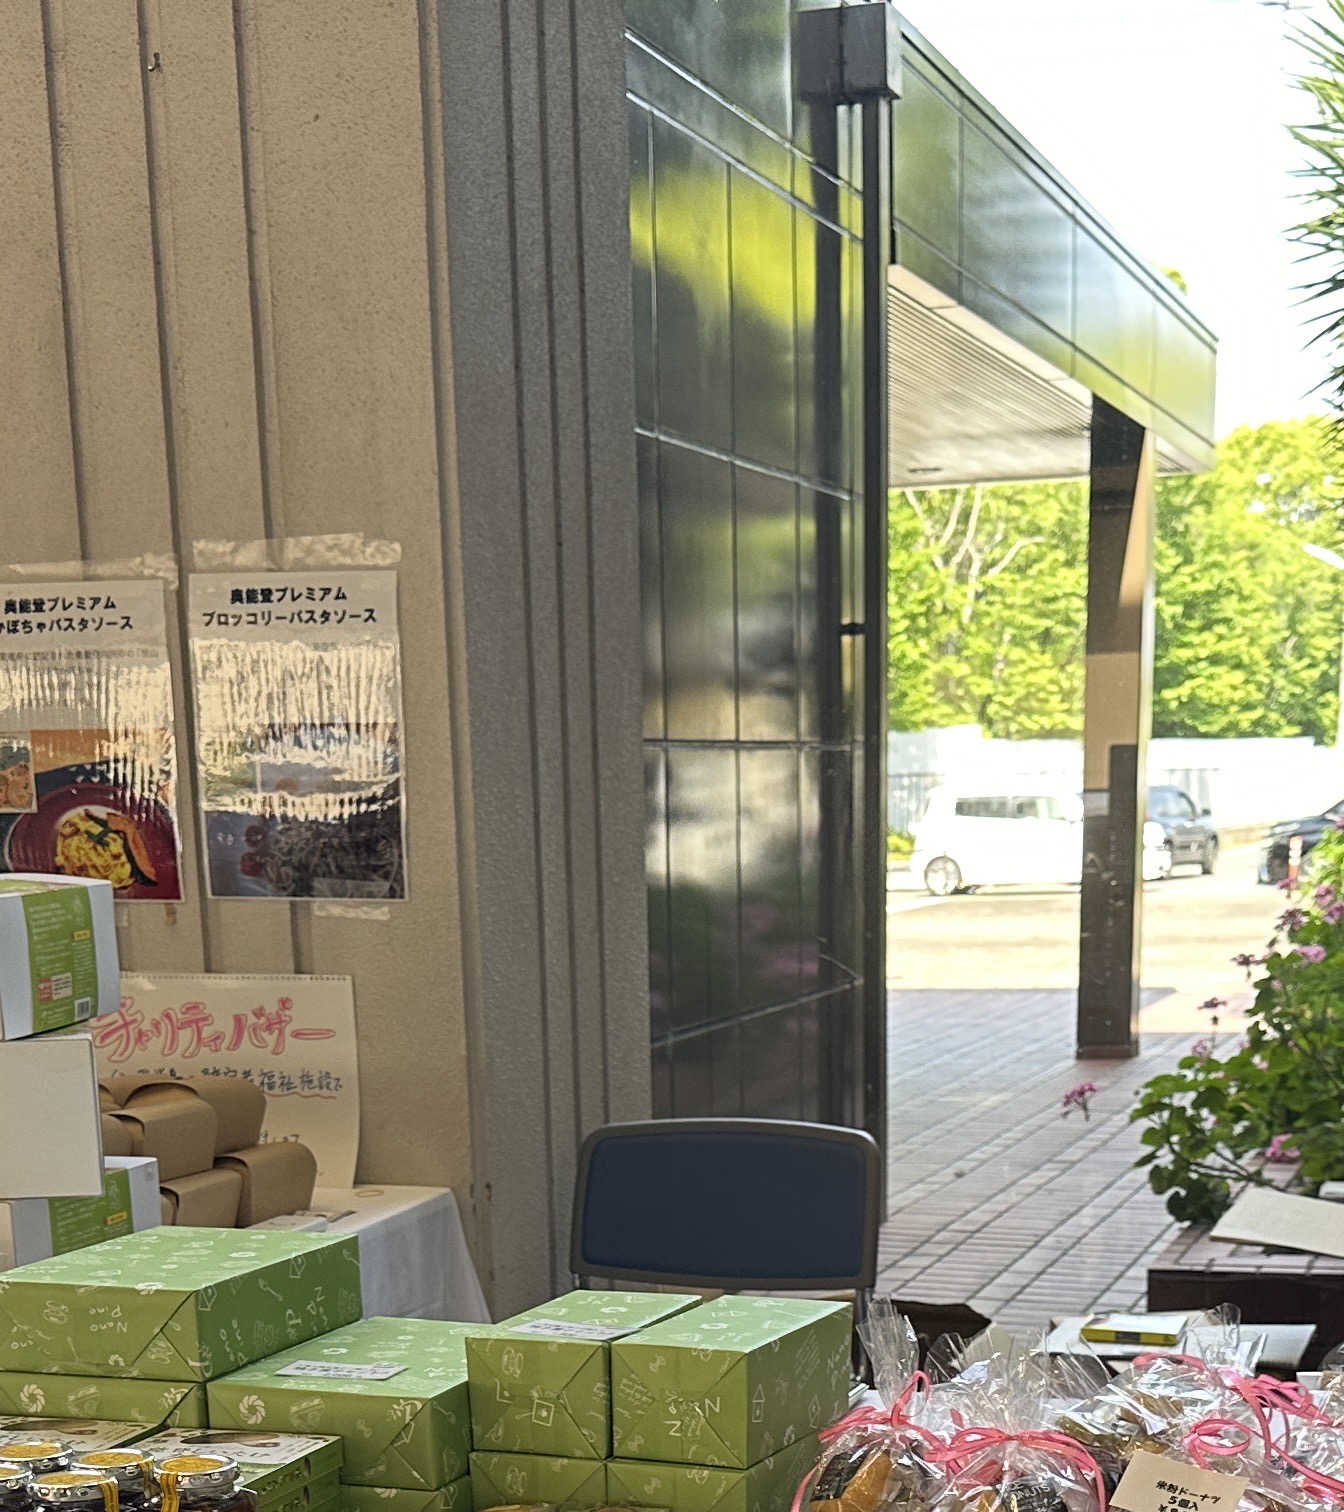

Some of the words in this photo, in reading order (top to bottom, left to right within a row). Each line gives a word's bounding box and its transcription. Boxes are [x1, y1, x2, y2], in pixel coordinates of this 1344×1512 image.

[230, 586, 347, 605] 奥能登プレミアム
[202, 608, 377, 627] ブロッコリーパスタソース
